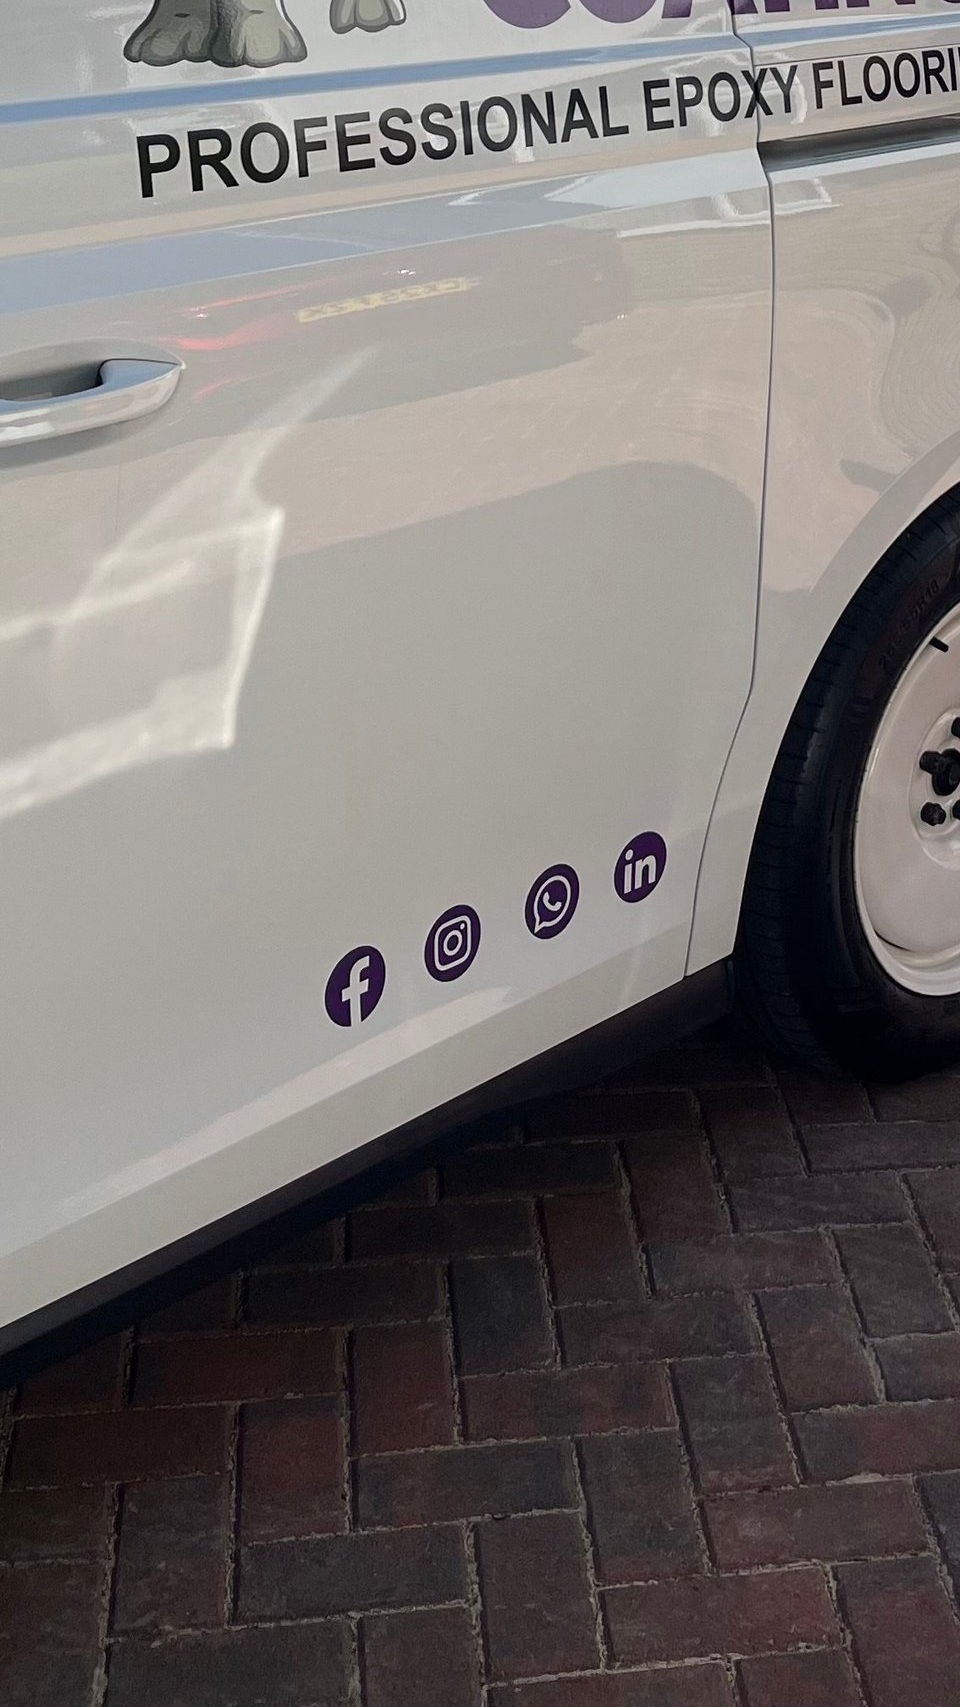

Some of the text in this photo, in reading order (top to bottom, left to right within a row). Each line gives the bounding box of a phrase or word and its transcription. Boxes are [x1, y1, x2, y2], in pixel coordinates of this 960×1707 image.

[136, 85, 630, 198] PROFESSIONAL
[642, 65, 798, 131] EPOXY
[622, 849, 657, 895] in
